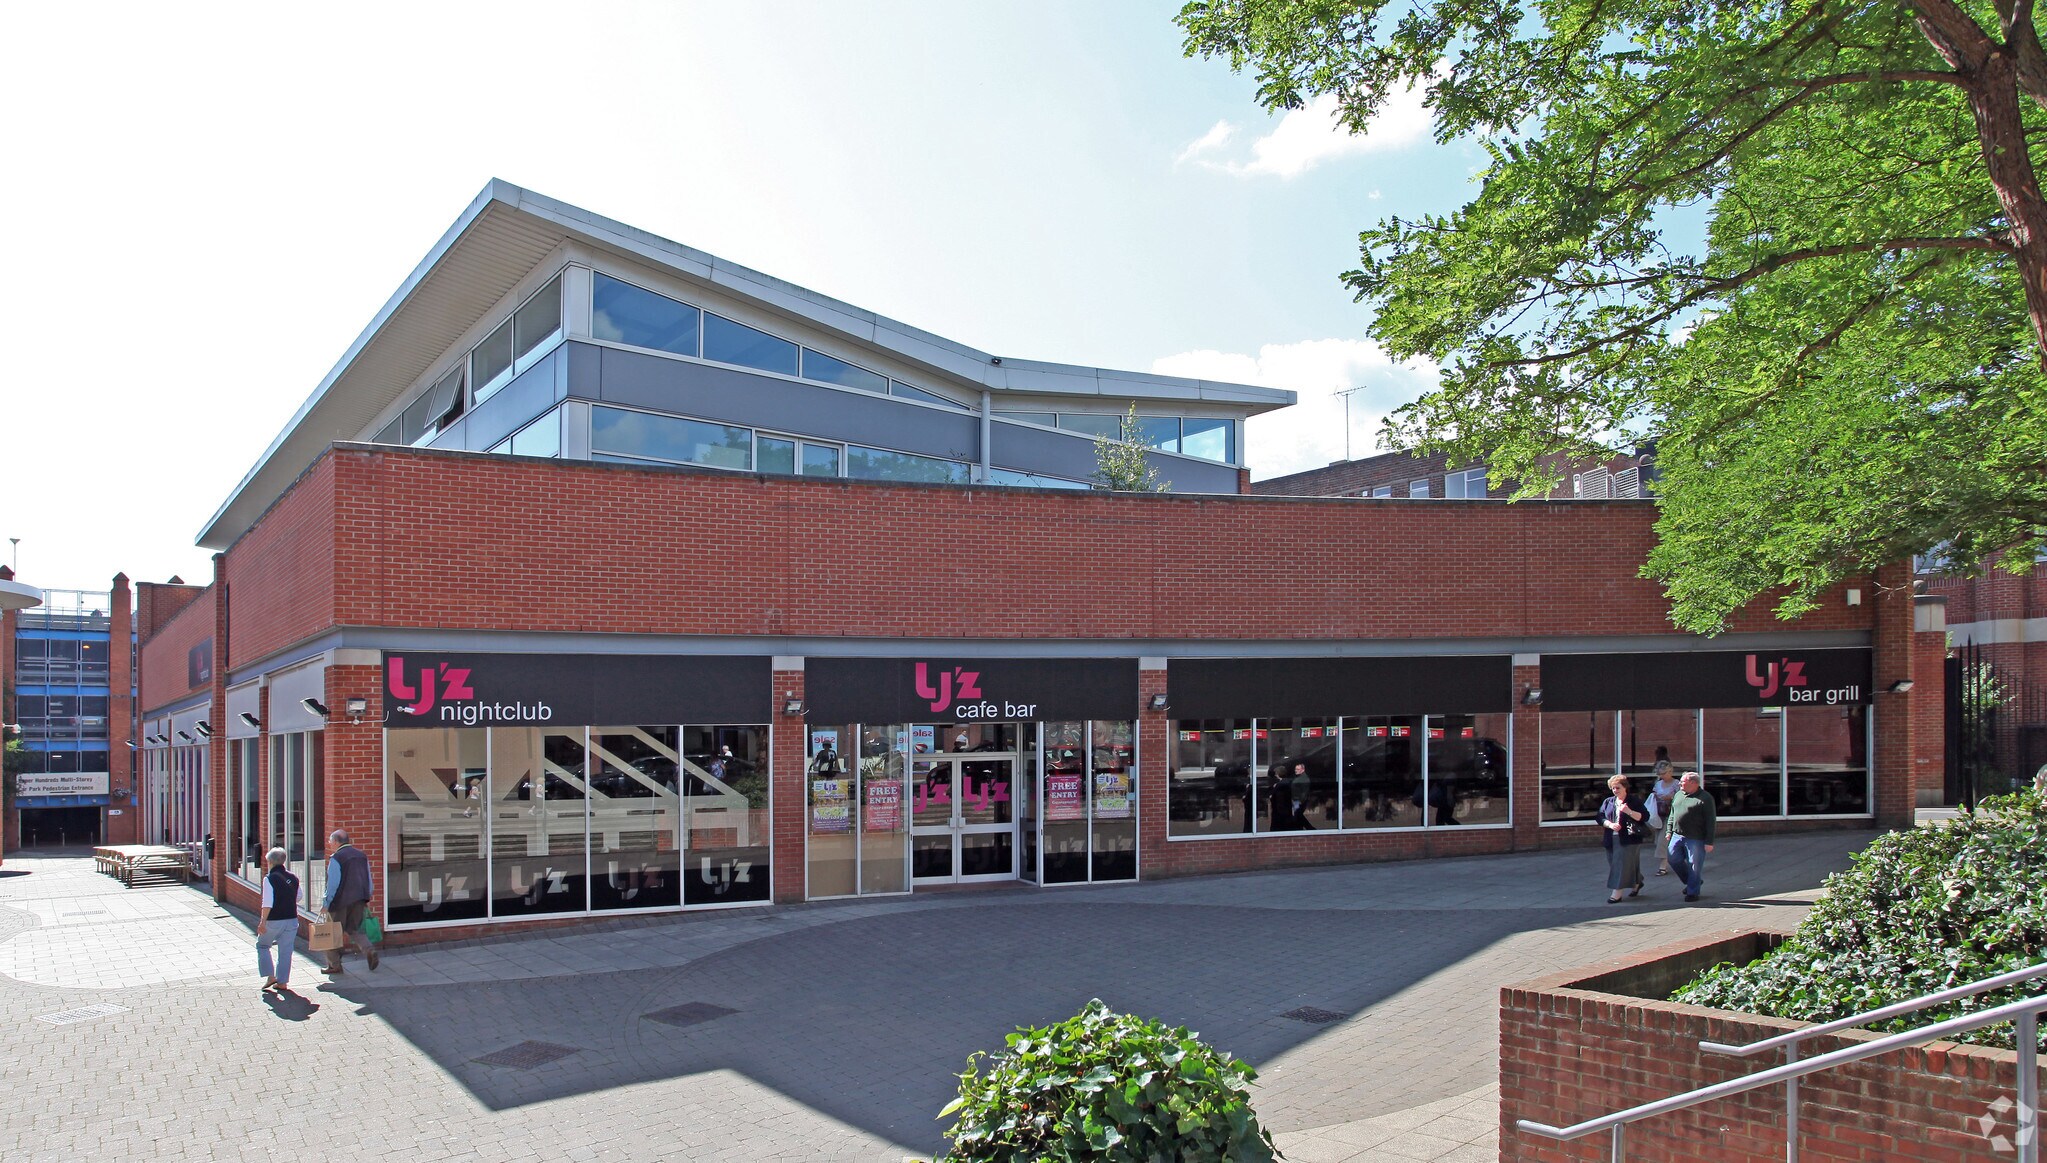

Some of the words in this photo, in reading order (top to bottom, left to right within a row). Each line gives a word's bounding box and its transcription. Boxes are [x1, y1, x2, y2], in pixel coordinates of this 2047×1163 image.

[1789, 686, 1820, 702] bar
[1826, 685, 1859, 705] grill
[441, 701, 552, 726] nightclub
[956, 701, 998, 718] cafe
[1005, 701, 1036, 717] bar
[870, 786, 898, 796] FREE
[1051, 782, 1078, 790] FREE
[870, 796, 897, 804] ENTRY
[1051, 791, 1078, 799] ENTRY
